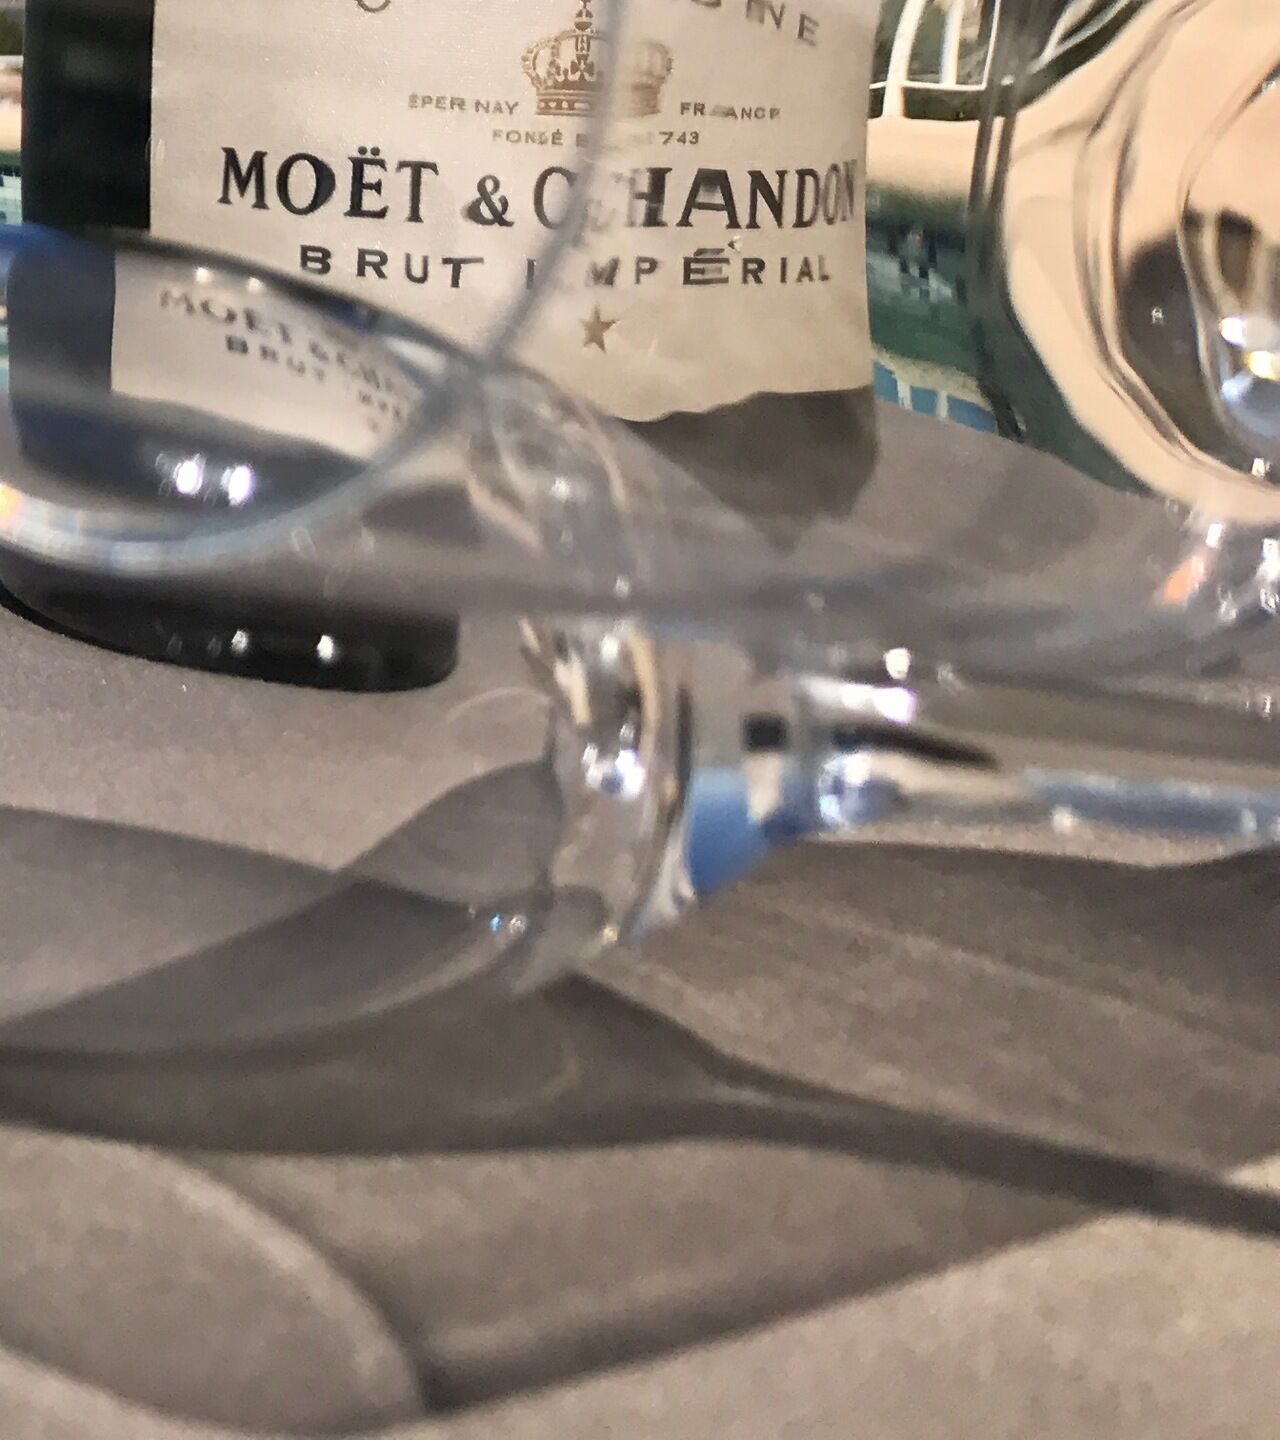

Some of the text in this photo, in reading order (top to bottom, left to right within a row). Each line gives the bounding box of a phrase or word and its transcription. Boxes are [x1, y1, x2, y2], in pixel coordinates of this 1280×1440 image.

[217, 146, 860, 230] MOËT & CHANDON
[300, 244, 831, 289] BRUT IMPÉRIAL
